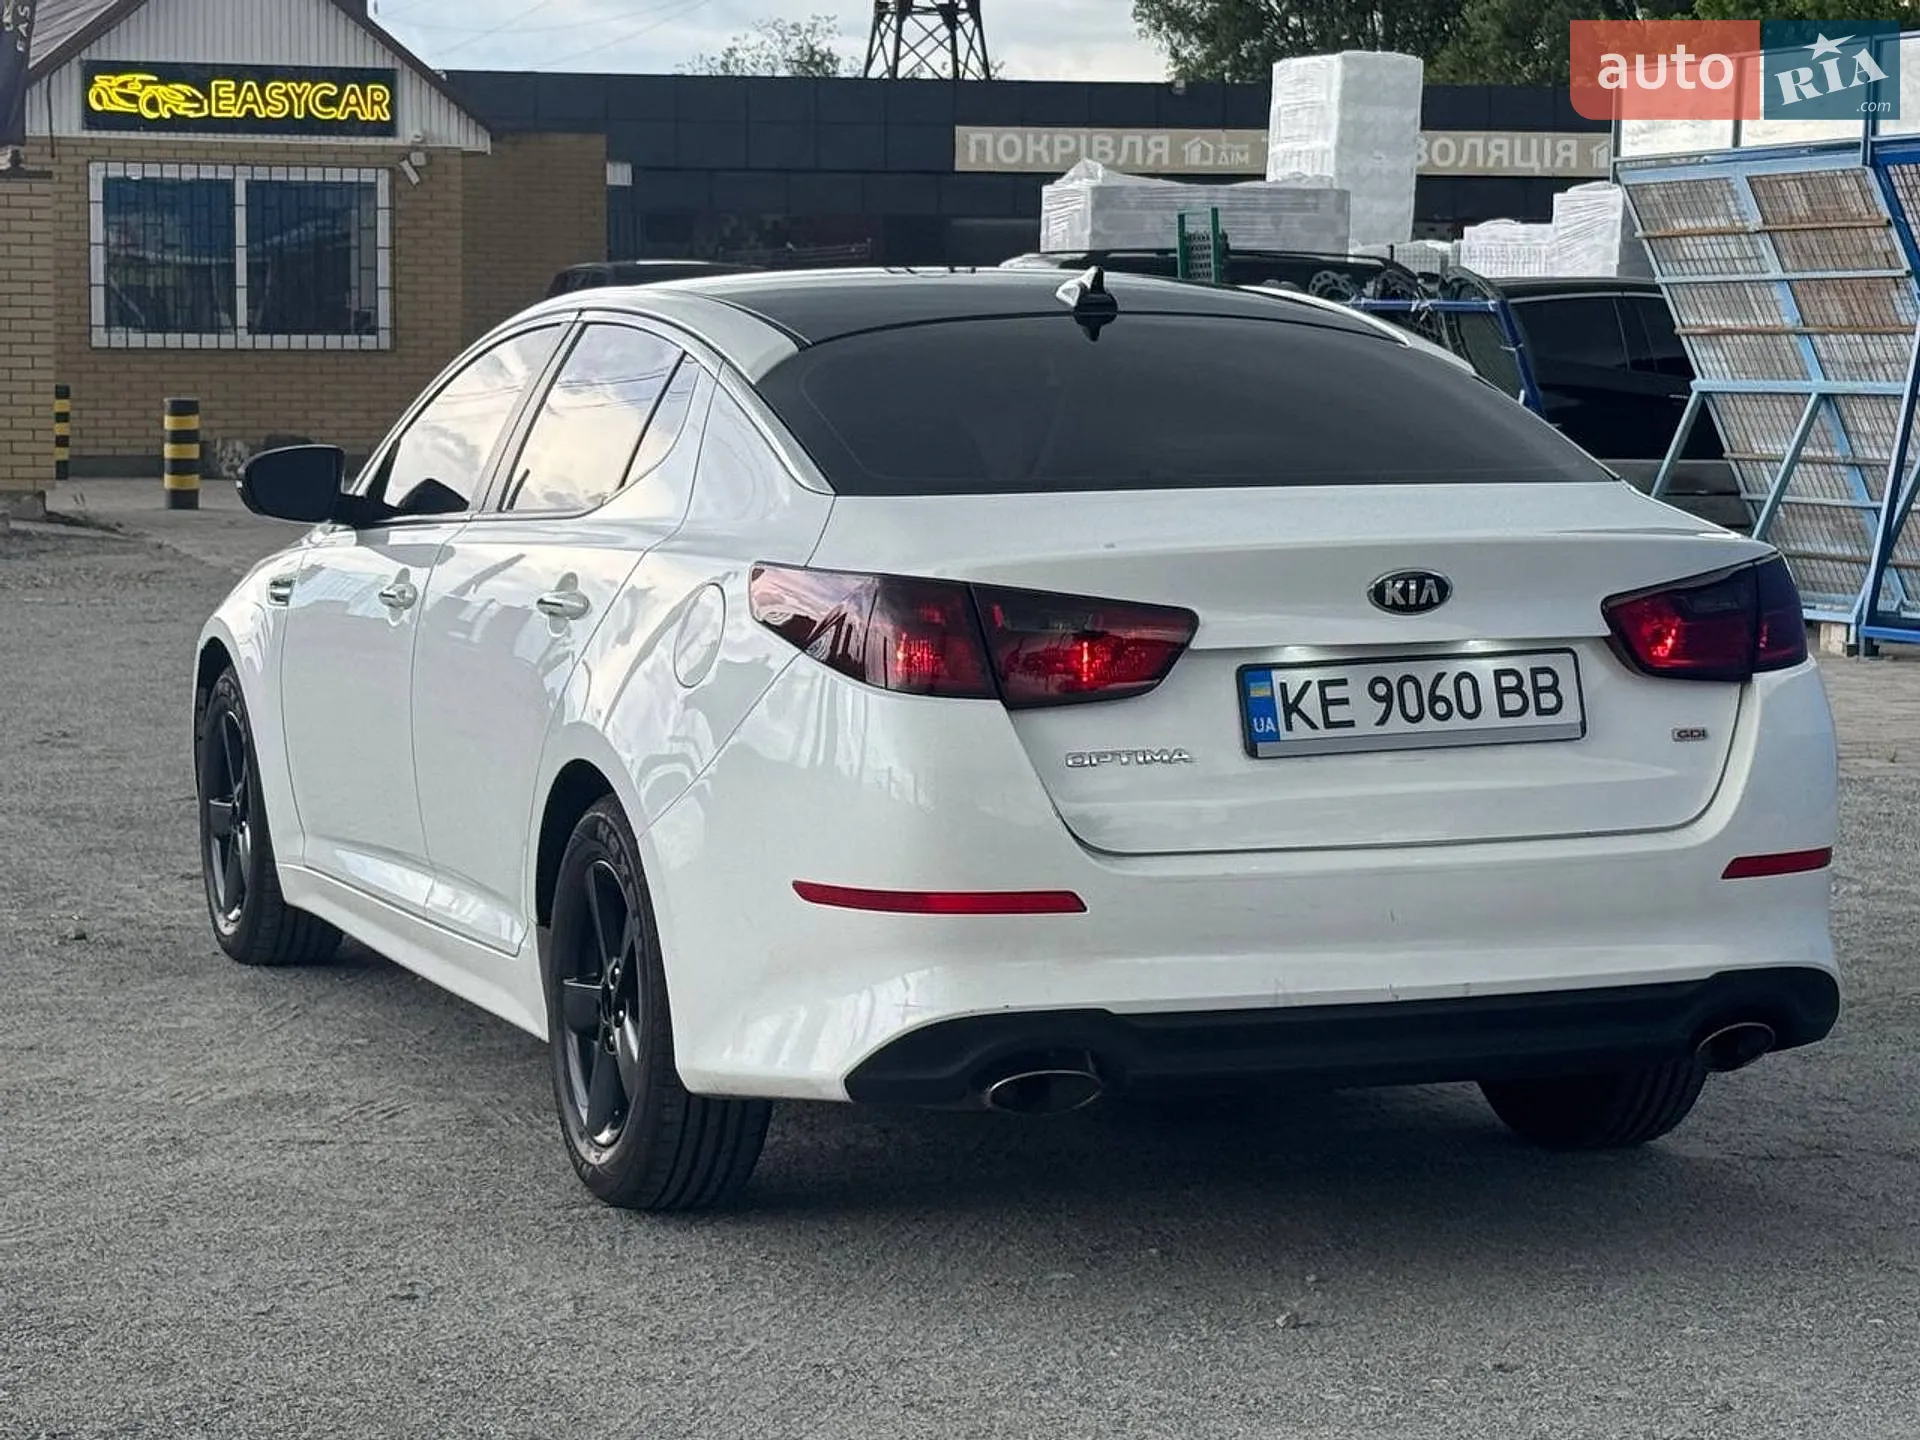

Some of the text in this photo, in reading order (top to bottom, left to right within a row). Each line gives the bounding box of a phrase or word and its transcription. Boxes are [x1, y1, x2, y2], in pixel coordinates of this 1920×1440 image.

[210, 80, 391, 121] EASYCAR
[968, 132, 1170, 166] ПОКРІВЛЯ
[1384, 579, 1440, 605] KIA
[1279, 666, 1564, 732] KE 9060 BB
[1253, 718, 1277, 734] UA
[1065, 747, 1194, 768] OPTIMA
